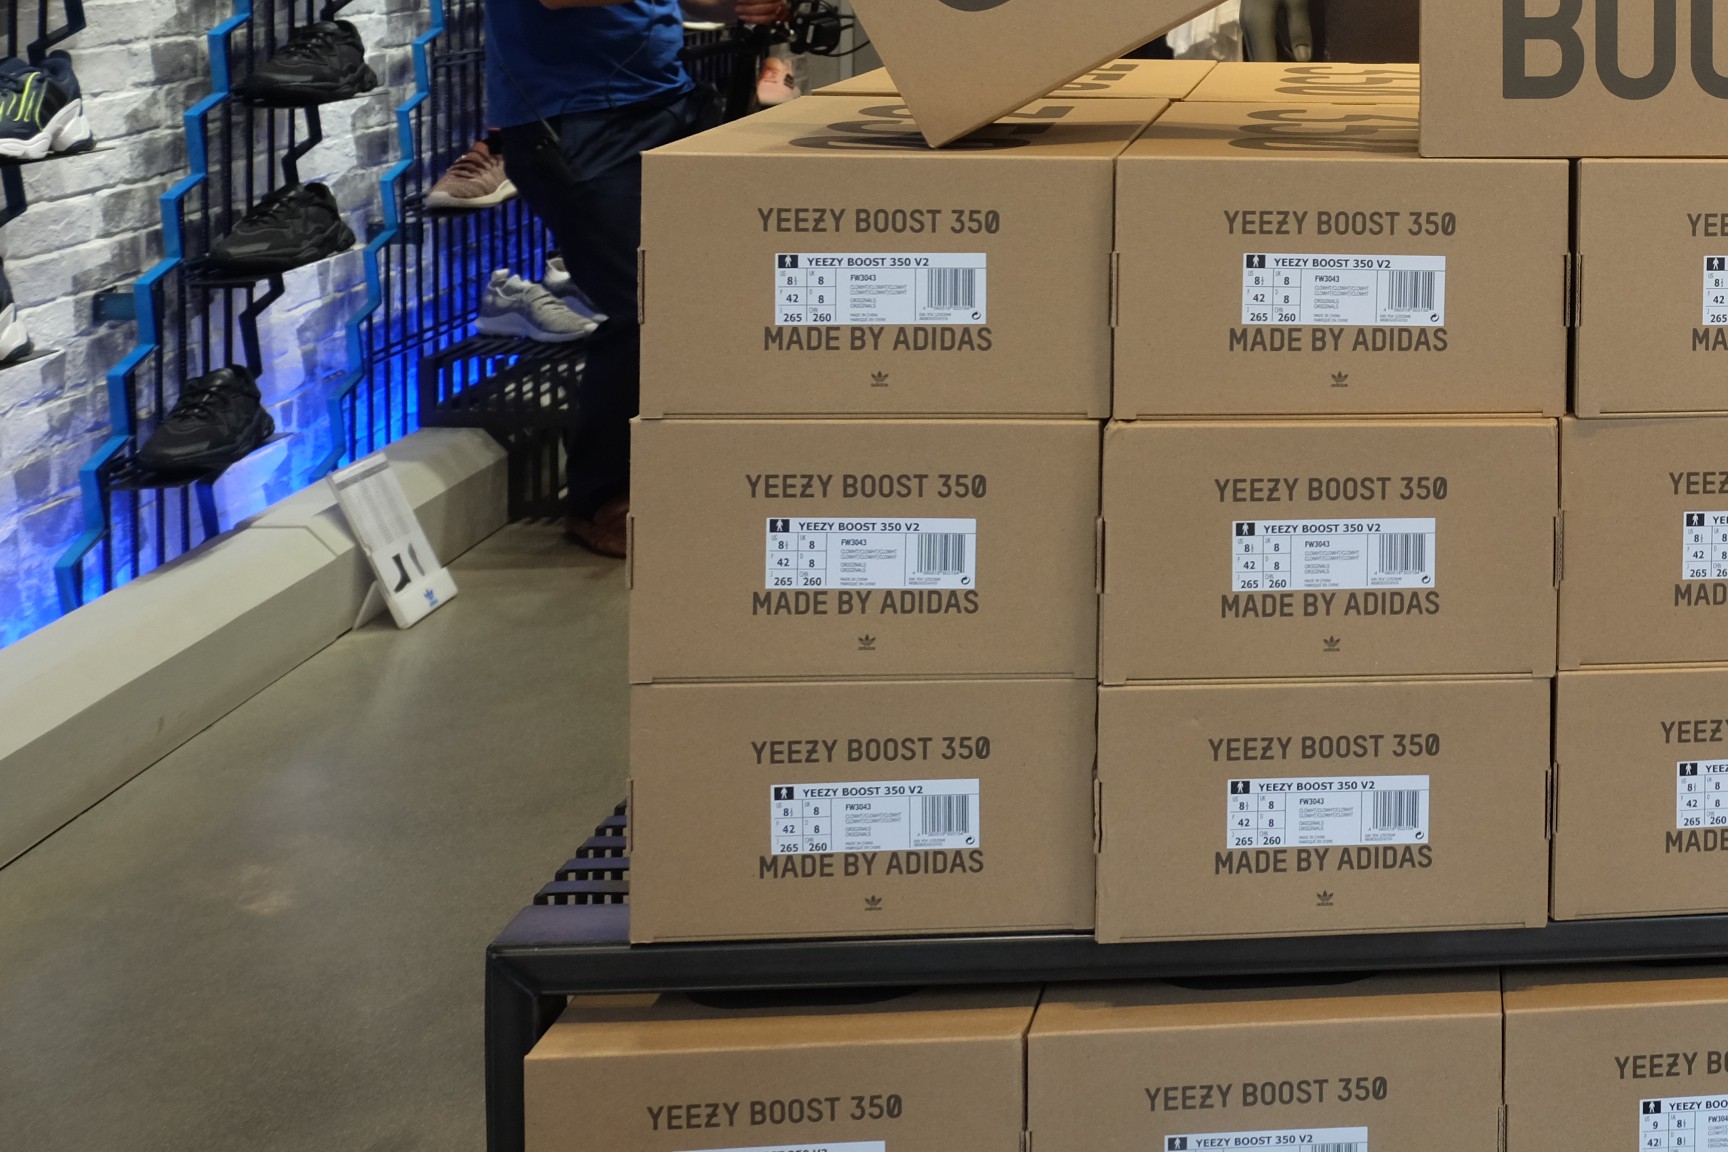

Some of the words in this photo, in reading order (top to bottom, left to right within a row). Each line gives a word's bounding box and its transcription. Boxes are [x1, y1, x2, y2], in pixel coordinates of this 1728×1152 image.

[758, 208, 845, 232] YEEZY
[856, 209, 941, 233] BOOST
[951, 210, 999, 233] 350
[1224, 211, 1307, 234] YEEZY
[1318, 211, 1399, 235] BOOST
[1409, 212, 1455, 235] 350
[808, 258, 843, 266] YEEZY
[848, 258, 886, 266] BOOST
[890, 258, 911, 266] 350
[914, 258, 928, 266] V2
[765, 327, 840, 350] MADE
[851, 327, 884, 350] BY
[893, 327, 992, 351] ADIDAS
[746, 475, 832, 498] YEEZY
[843, 474, 928, 498] BOOST
[938, 475, 986, 498] 350
[1215, 478, 1298, 502] YEEZY
[1309, 477, 1391, 500] BOOST
[1400, 477, 1447, 500] 350
[752, 740, 837, 764] YEEZY
[848, 738, 932, 761] BOOST
[942, 737, 990, 759] 350
[1209, 737, 1291, 761] YEEZY
[1302, 735, 1384, 758] BOOST
[1393, 734, 1439, 757] 350
[1215, 850, 1287, 875] MADE
[1297, 848, 1329, 871] BY
[1338, 845, 1432, 870] ADIDAS
[1615, 1052, 1697, 1079] YEEZY
[1145, 1084, 1232, 1111] YEEZY
[1243, 1079, 1328, 1106] BOOST
[1338, 1077, 1387, 1101] 350
[1669, 1101, 1702, 1111] YEEZY
[648, 1103, 739, 1130] YEEZY
[751, 1098, 839, 1125] BOOST
[851, 1095, 901, 1120] 350
